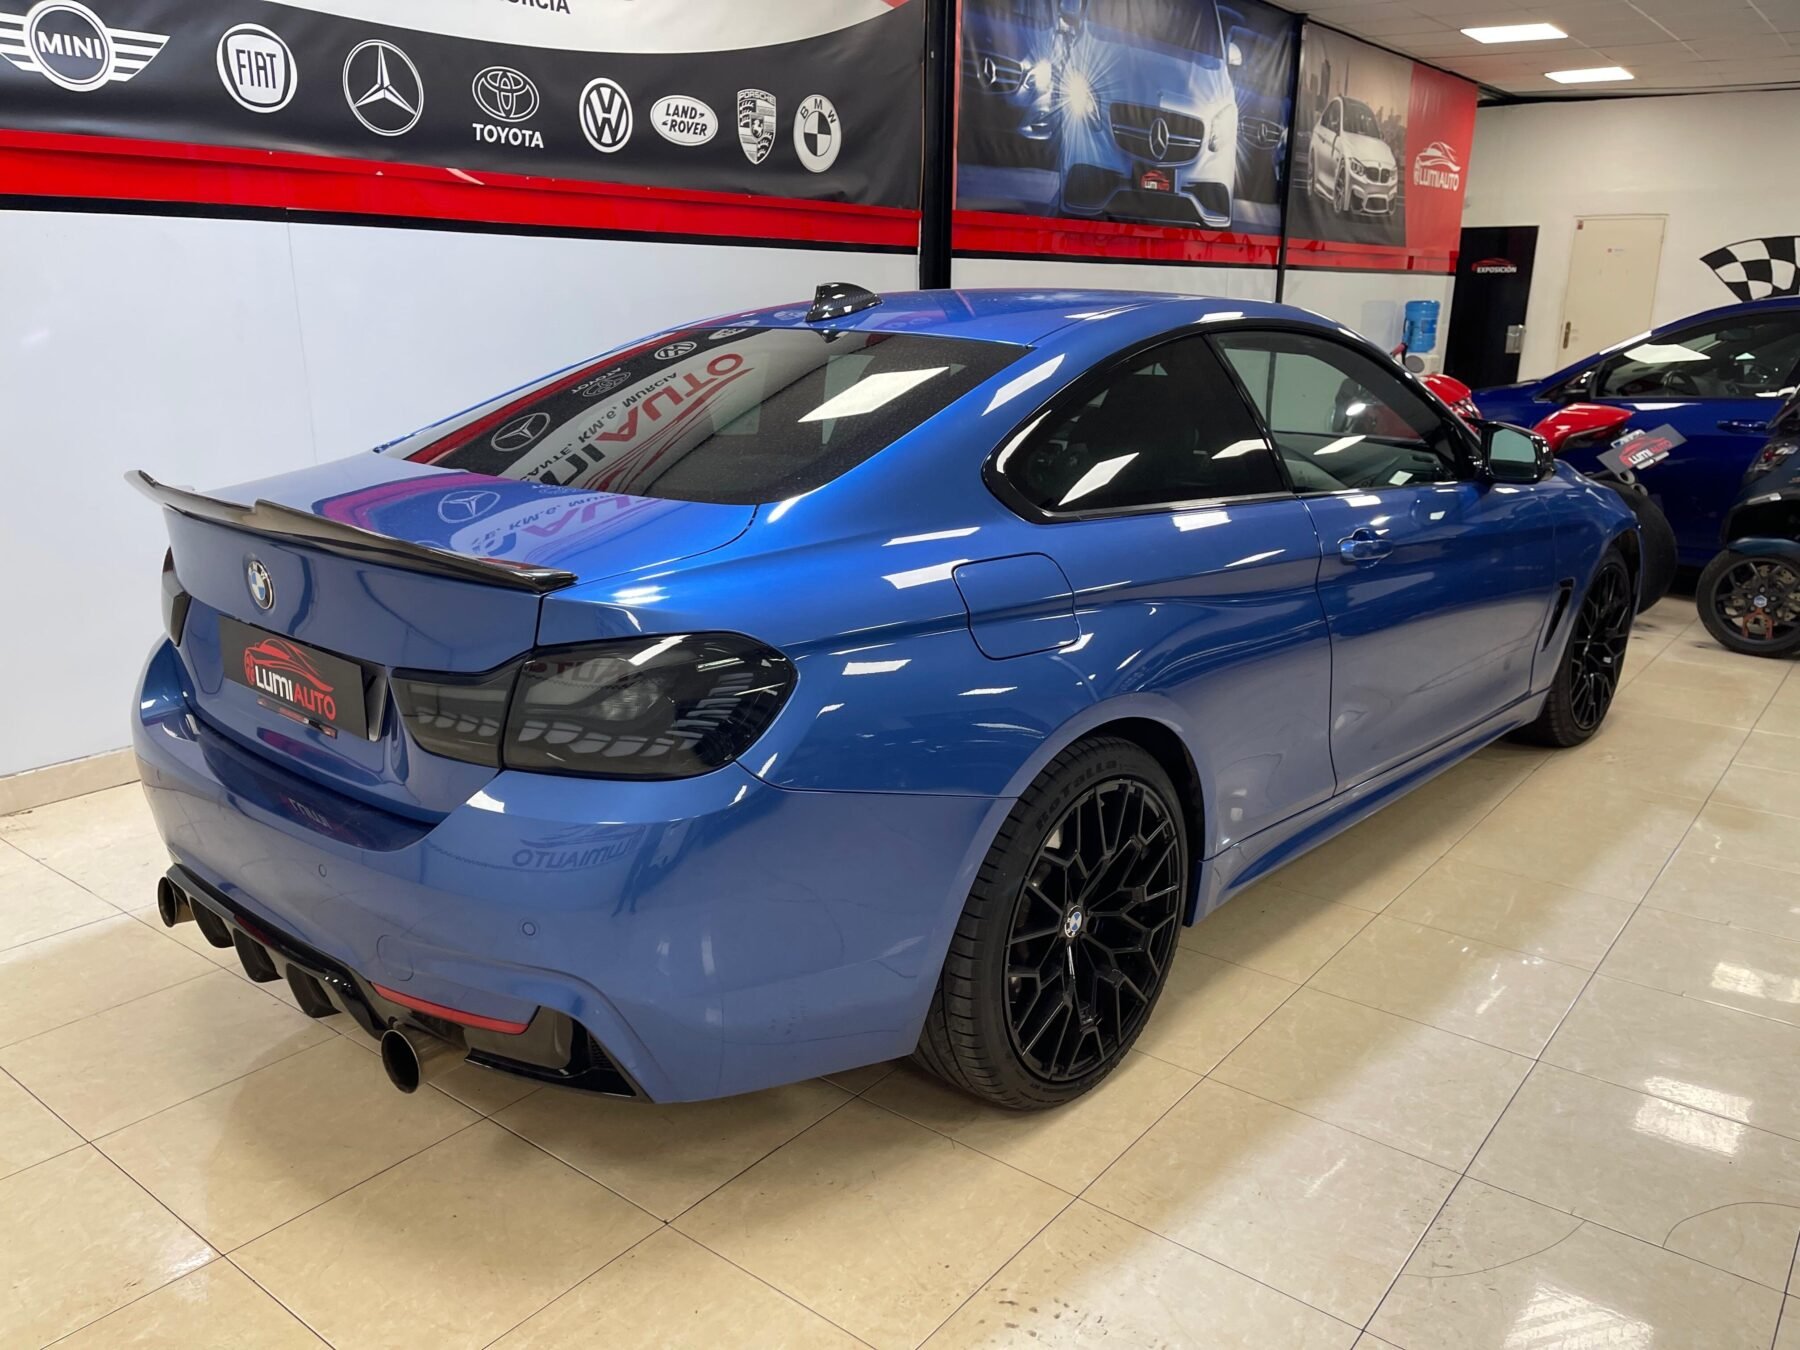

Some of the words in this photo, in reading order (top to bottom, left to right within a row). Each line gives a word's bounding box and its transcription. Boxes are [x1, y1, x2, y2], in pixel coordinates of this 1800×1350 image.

[36, 31, 102, 60] MINI
[236, 50, 277, 90] FIAT
[738, 90, 775, 106] PORSCHE
[665, 103, 698, 120] LAND
[800, 98, 836, 125] BMW
[472, 123, 544, 148] TOYOTA
[669, 120, 707, 136] ROVER
[254, 665, 337, 720] LUMIAUTO
